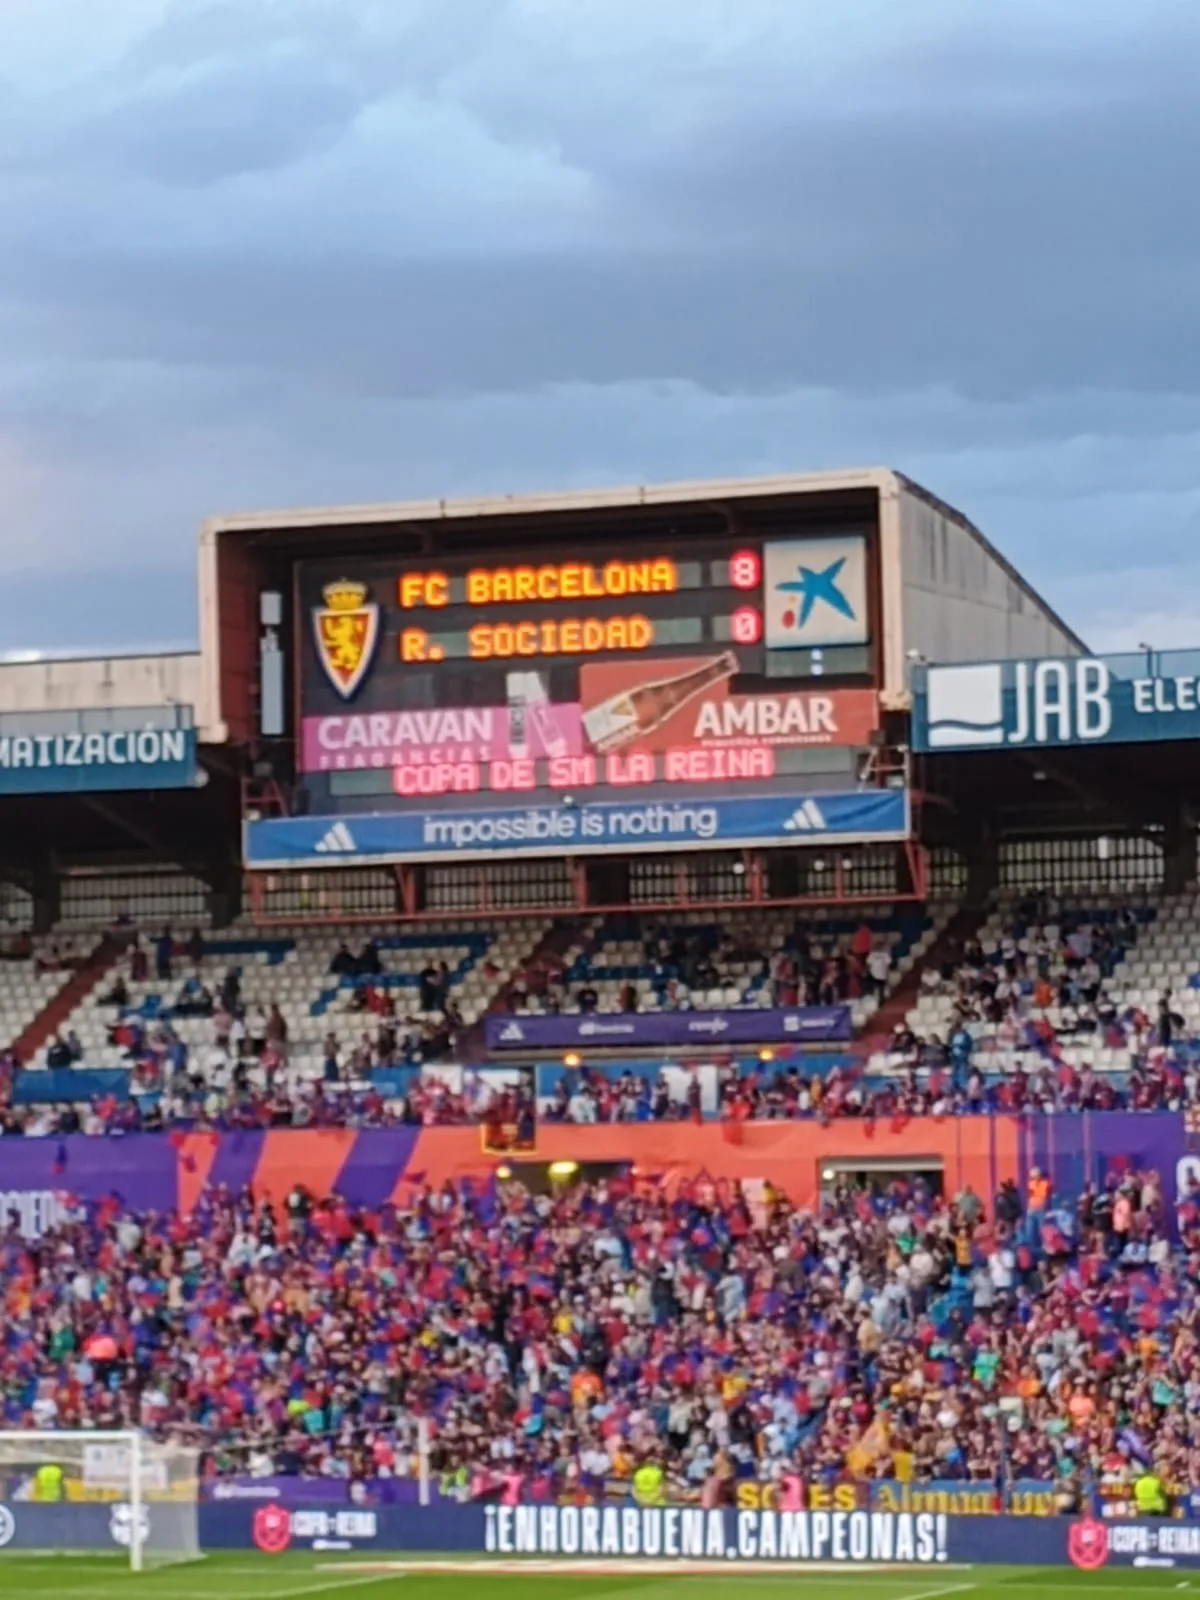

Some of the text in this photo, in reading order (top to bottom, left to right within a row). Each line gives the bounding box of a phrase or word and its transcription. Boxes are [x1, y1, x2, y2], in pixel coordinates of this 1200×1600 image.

[400, 553, 759, 608] FC BARCELONA 8
[401, 609, 760, 661] R. SOCIEDAD 0
[694, 696, 839, 738] AMBAR
[1008, 659, 1200, 743] JAB ELE
[318, 708, 493, 750] CARAVAN
[394, 746, 774, 795] COPA DE SM LA REINA
[423, 804, 717, 848] impossible is nothing
